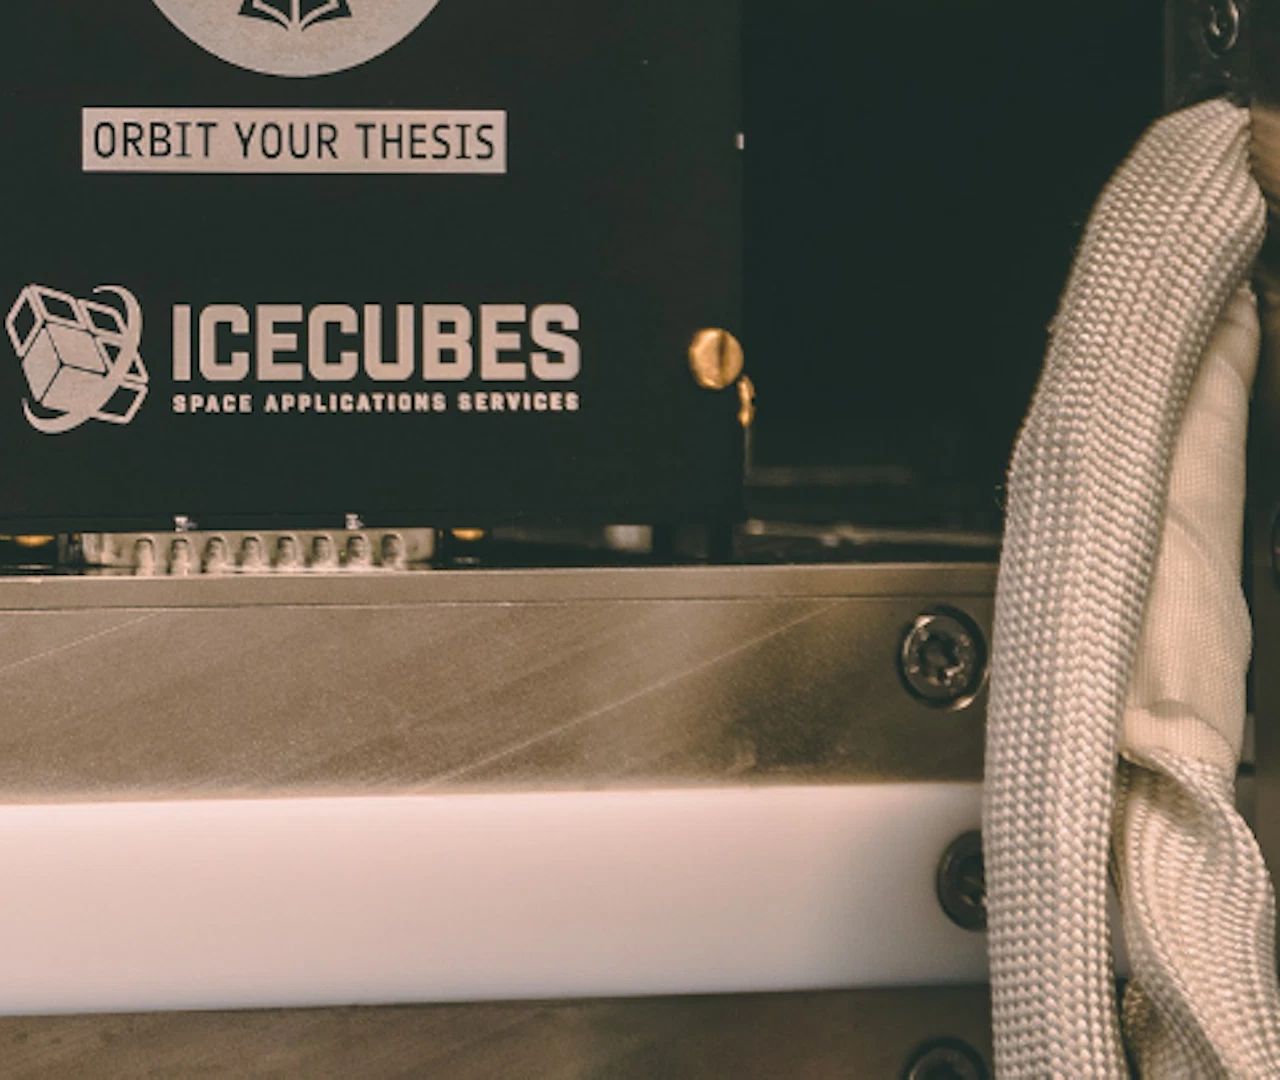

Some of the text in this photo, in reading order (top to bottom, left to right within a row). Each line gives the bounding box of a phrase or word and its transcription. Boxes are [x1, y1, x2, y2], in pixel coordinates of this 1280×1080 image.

[93, 122, 495, 160] ORBIT YOUR THESIS
[172, 304, 580, 381] ICECUBES
[172, 392, 580, 414] SPACE APPLICATIONS SERVICES
